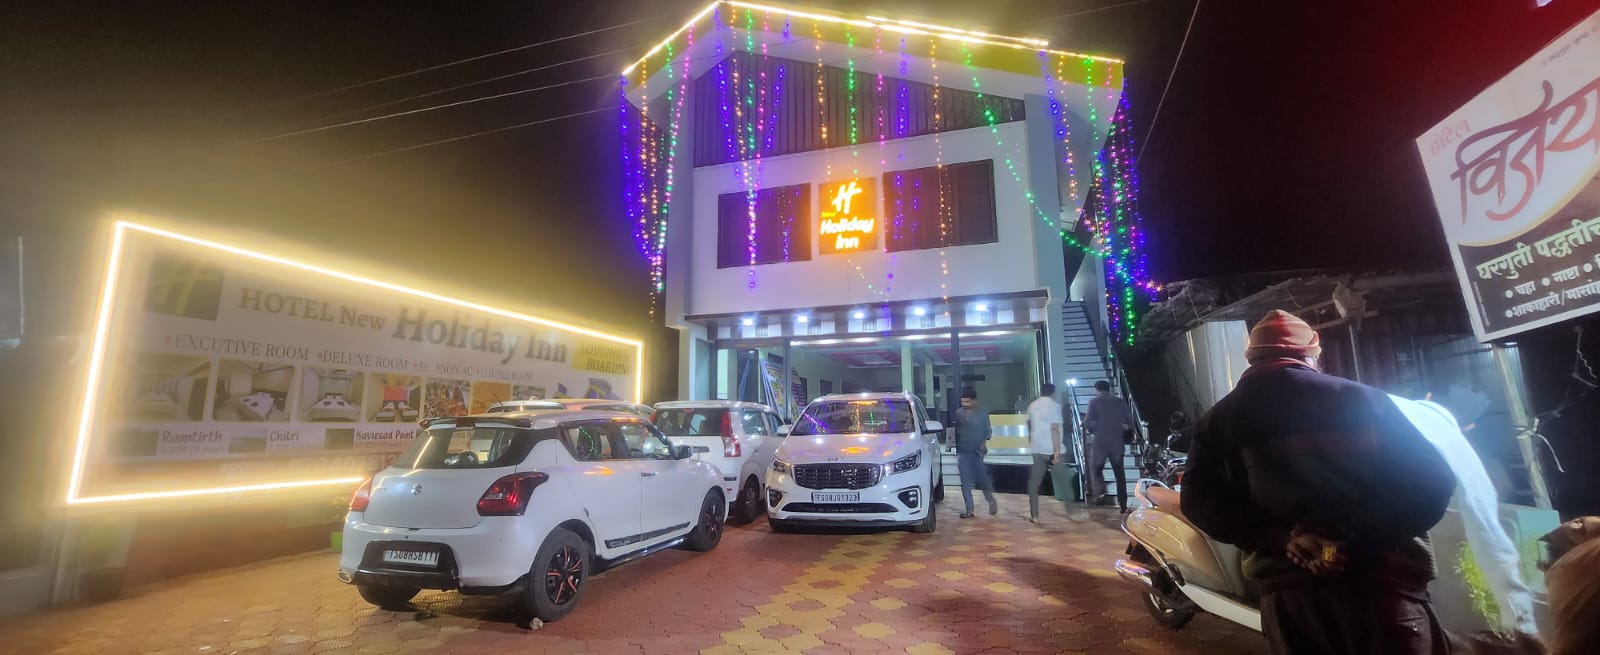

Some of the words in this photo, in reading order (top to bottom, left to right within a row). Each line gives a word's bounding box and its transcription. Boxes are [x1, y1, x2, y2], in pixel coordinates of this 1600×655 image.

[820, 217, 875, 234] Holiday
[836, 234, 859, 250] Inn
[1476, 242, 1534, 279] घरगुती
[1514, 281, 1536, 295] चहा
[238, 287, 334, 322] HOTEL
[339, 305, 387, 331] New
[391, 306, 521, 365] Holiday
[525, 329, 567, 363] Inn
[175, 334, 262, 356] EXCUTIVE
[265, 343, 309, 361] ROOM
[322, 351, 373, 369] DELUXE
[375, 354, 408, 370] ROOM
[160, 430, 223, 444] Ramtirth
[269, 430, 300, 443] Chitri
[395, 429, 414, 440] Point
